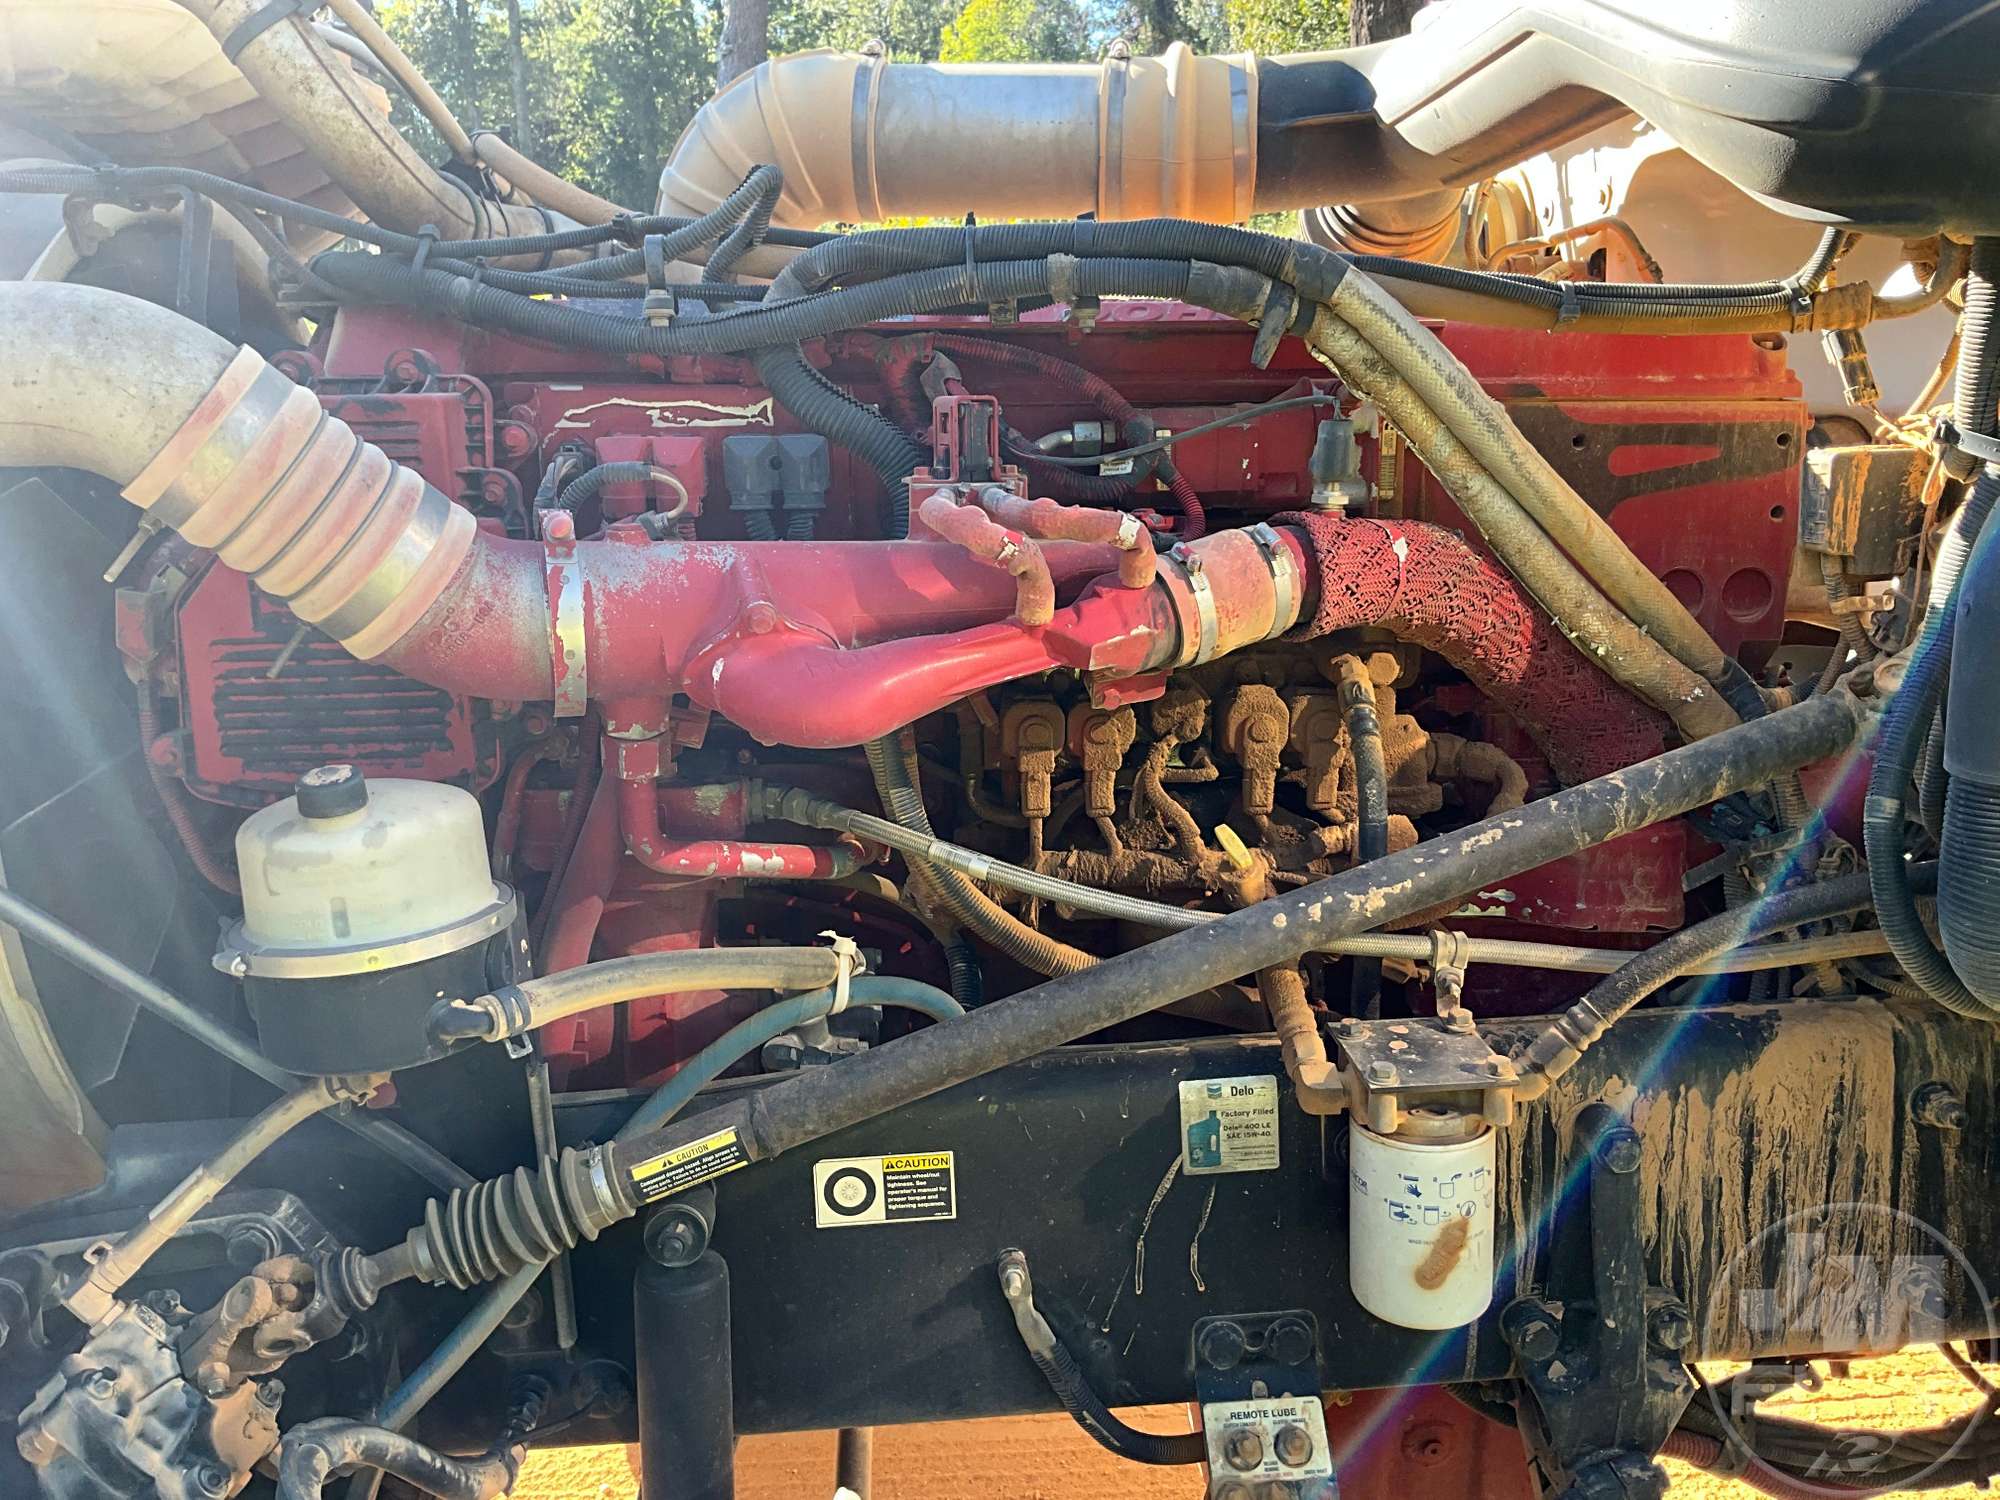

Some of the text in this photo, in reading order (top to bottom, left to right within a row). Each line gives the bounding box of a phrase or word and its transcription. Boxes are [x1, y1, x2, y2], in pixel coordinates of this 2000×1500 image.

[1230, 1085, 1254, 1097] Delo
[1221, 1110, 1251, 1118] Factory
[676, 1144, 709, 1161] CAUTION
[895, 1157, 948, 1169] CAUTION
[1230, 1408, 1297, 1420] REMOTE LUBE
